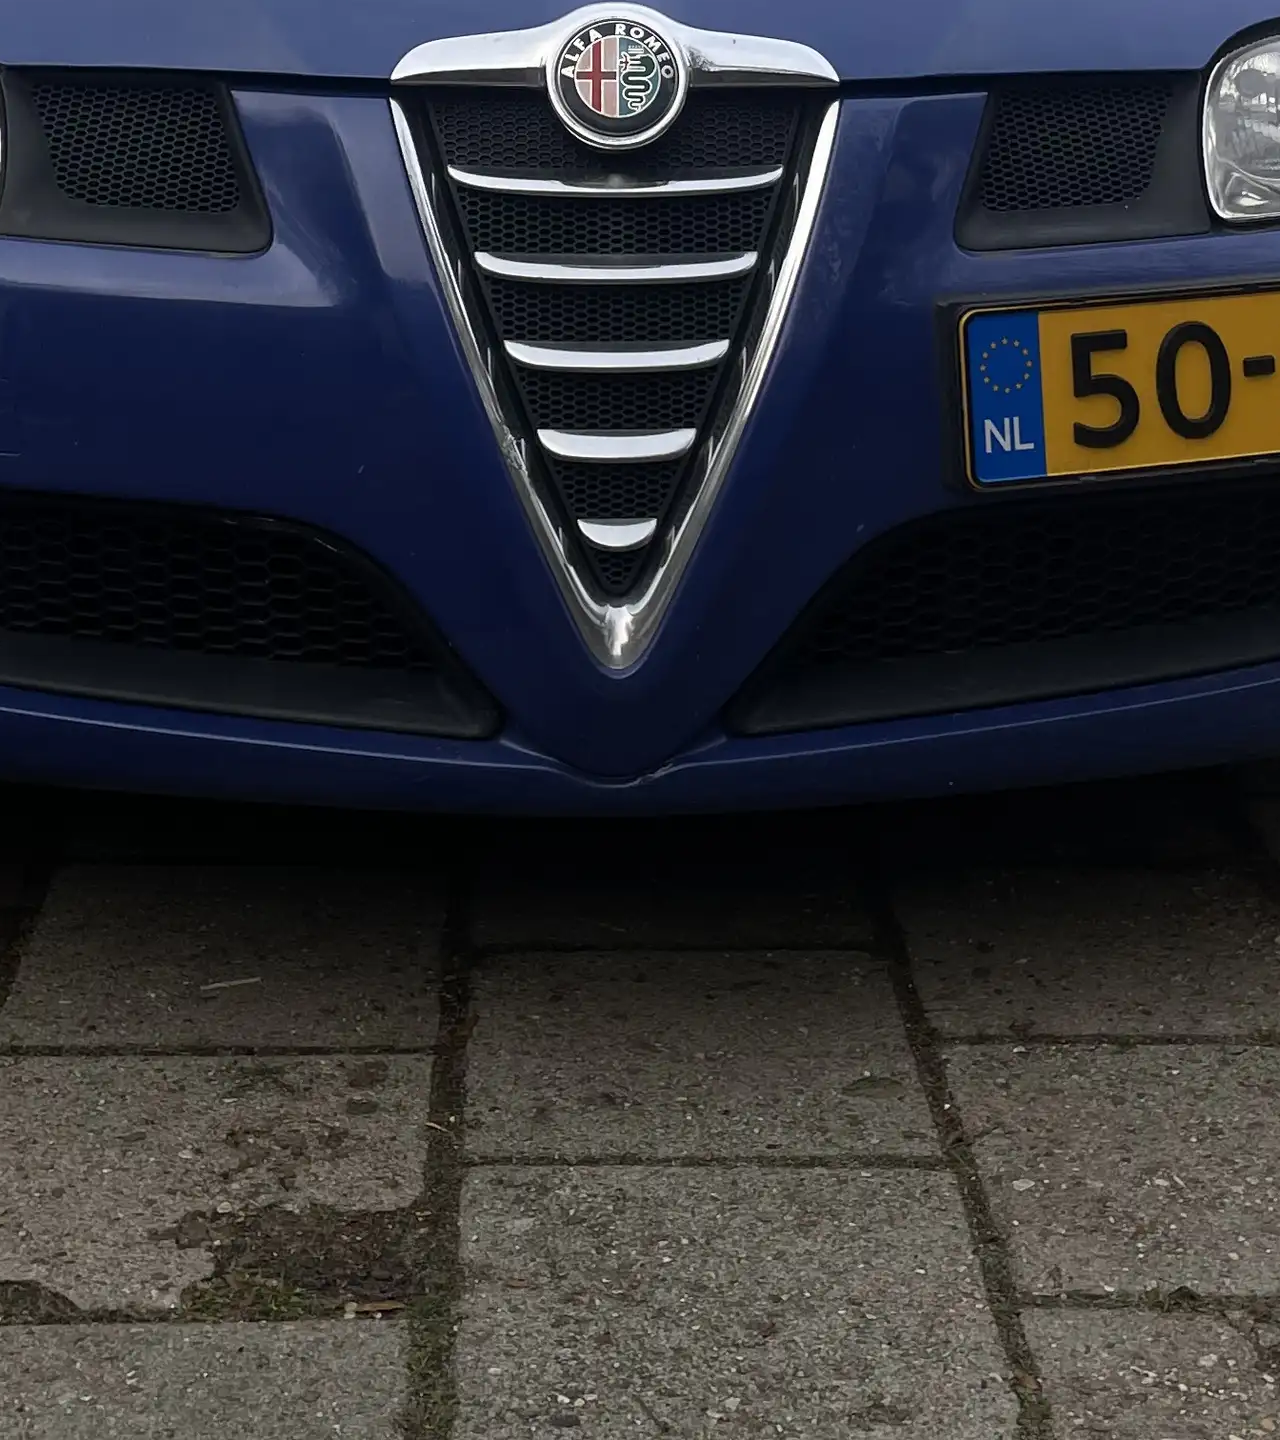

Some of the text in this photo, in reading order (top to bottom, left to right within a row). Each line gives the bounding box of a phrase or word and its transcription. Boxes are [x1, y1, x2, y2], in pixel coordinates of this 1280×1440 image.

[560, 23, 675, 79] ALFA ROMEO
[983, 415, 1036, 454] NL
